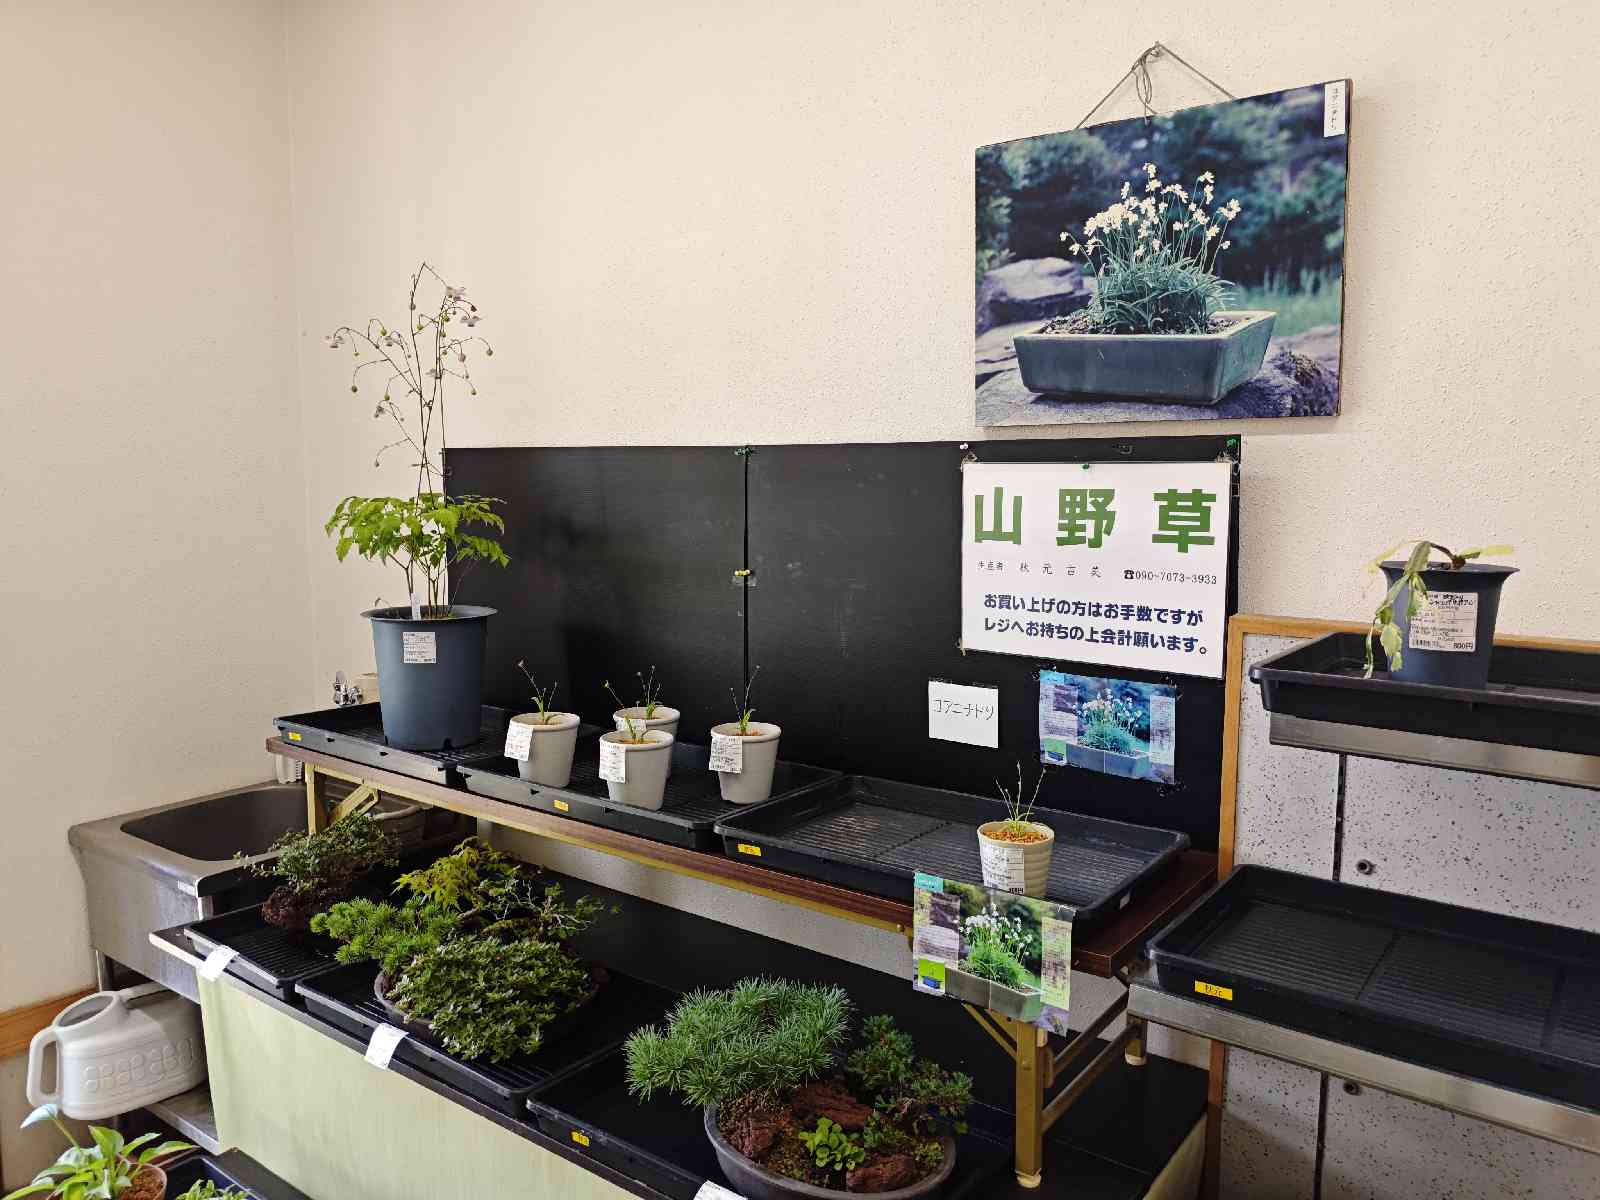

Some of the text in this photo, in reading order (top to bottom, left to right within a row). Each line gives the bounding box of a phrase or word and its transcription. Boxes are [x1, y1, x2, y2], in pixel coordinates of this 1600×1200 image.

[974, 486, 1217, 554] 山野草
[984, 593, 1204, 627] お買い上げの方はお手数ですが
[984, 616, 1208, 655] レジへお持ちの上会計願います。
